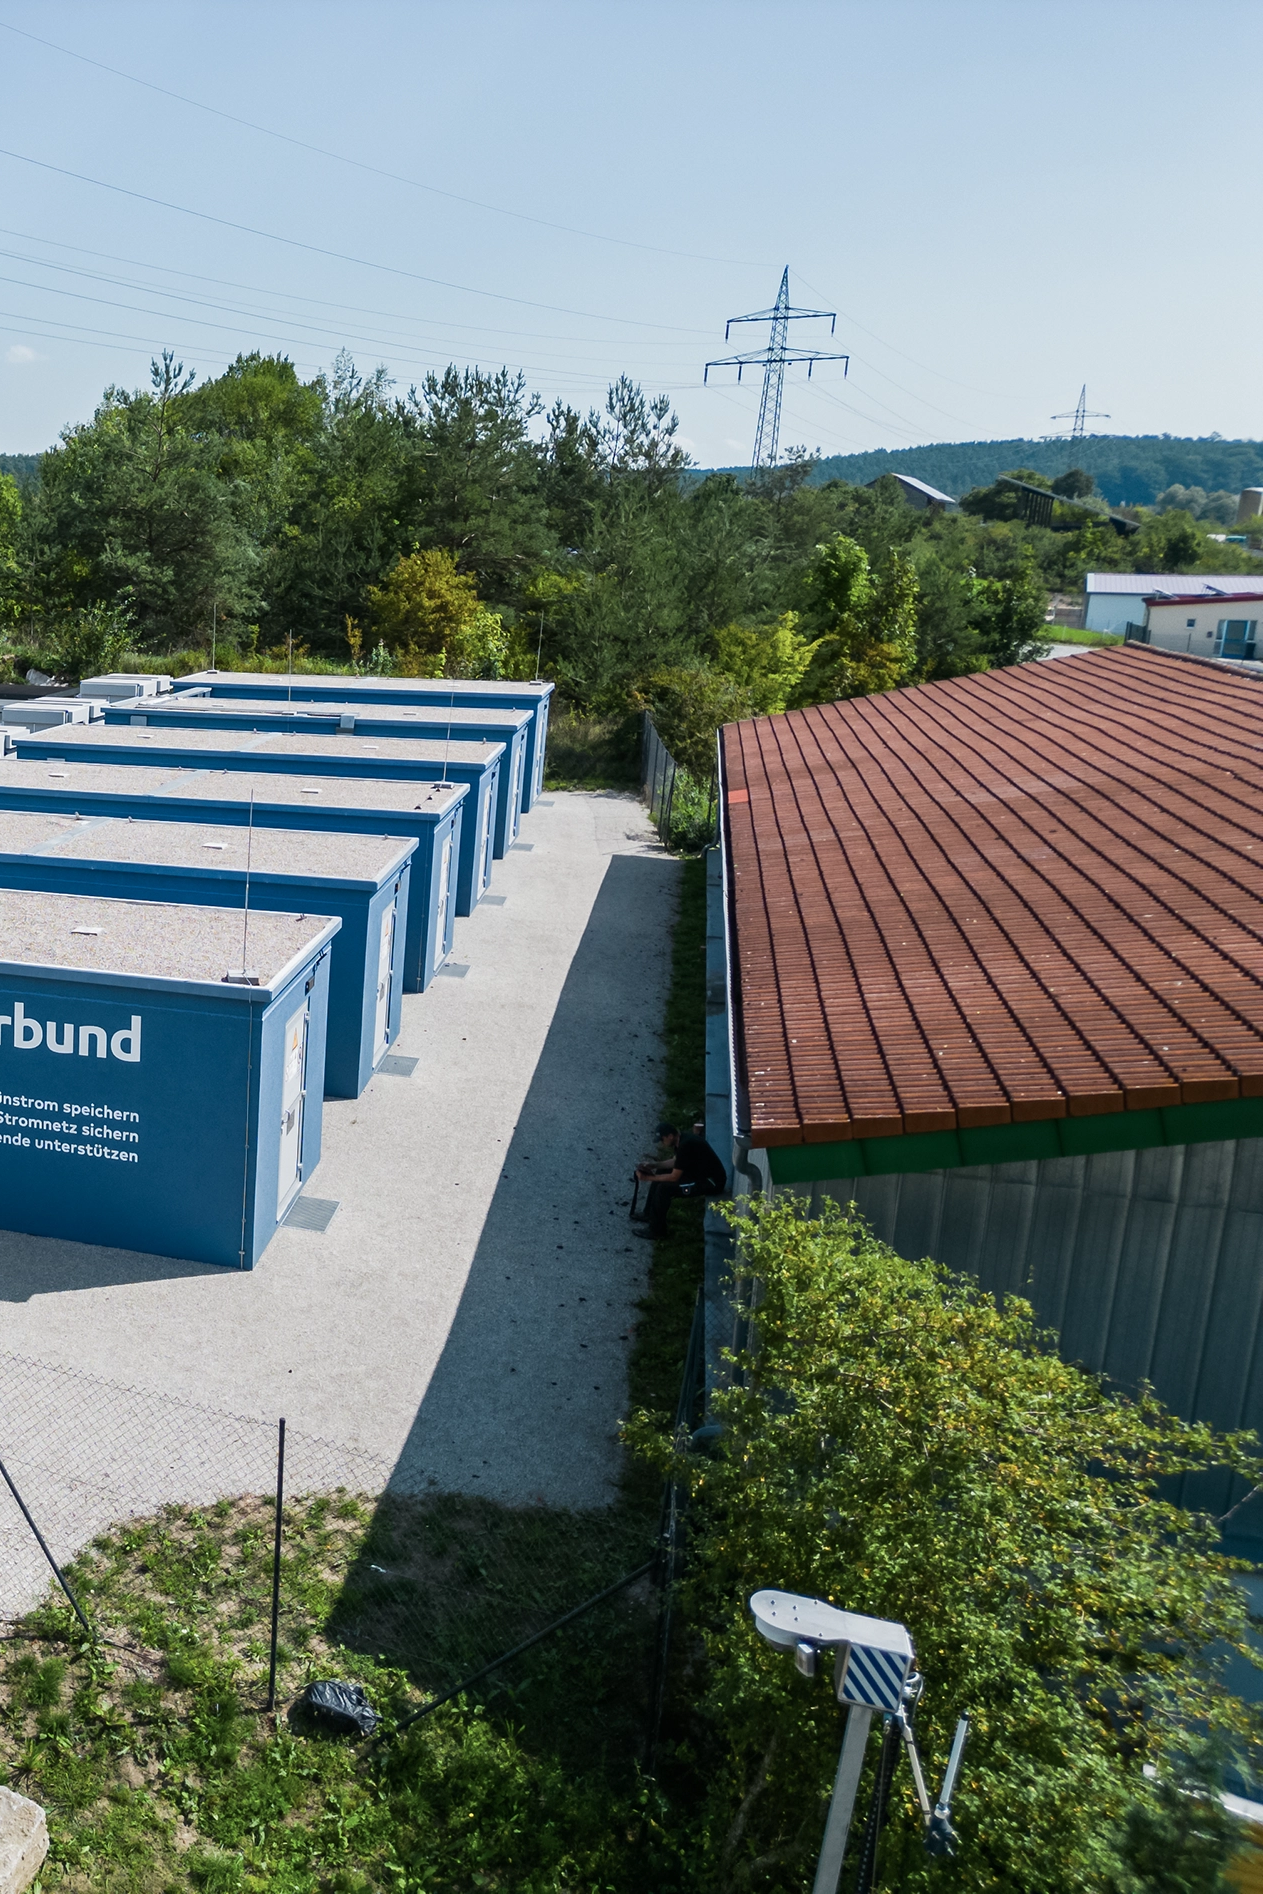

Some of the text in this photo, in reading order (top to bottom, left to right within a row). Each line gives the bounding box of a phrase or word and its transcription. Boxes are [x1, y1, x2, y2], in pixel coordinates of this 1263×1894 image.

[62, 1102, 140, 1122] speichern
[82, 1124, 139, 1143] sichern
[34, 1138, 138, 1163] unterstützen
